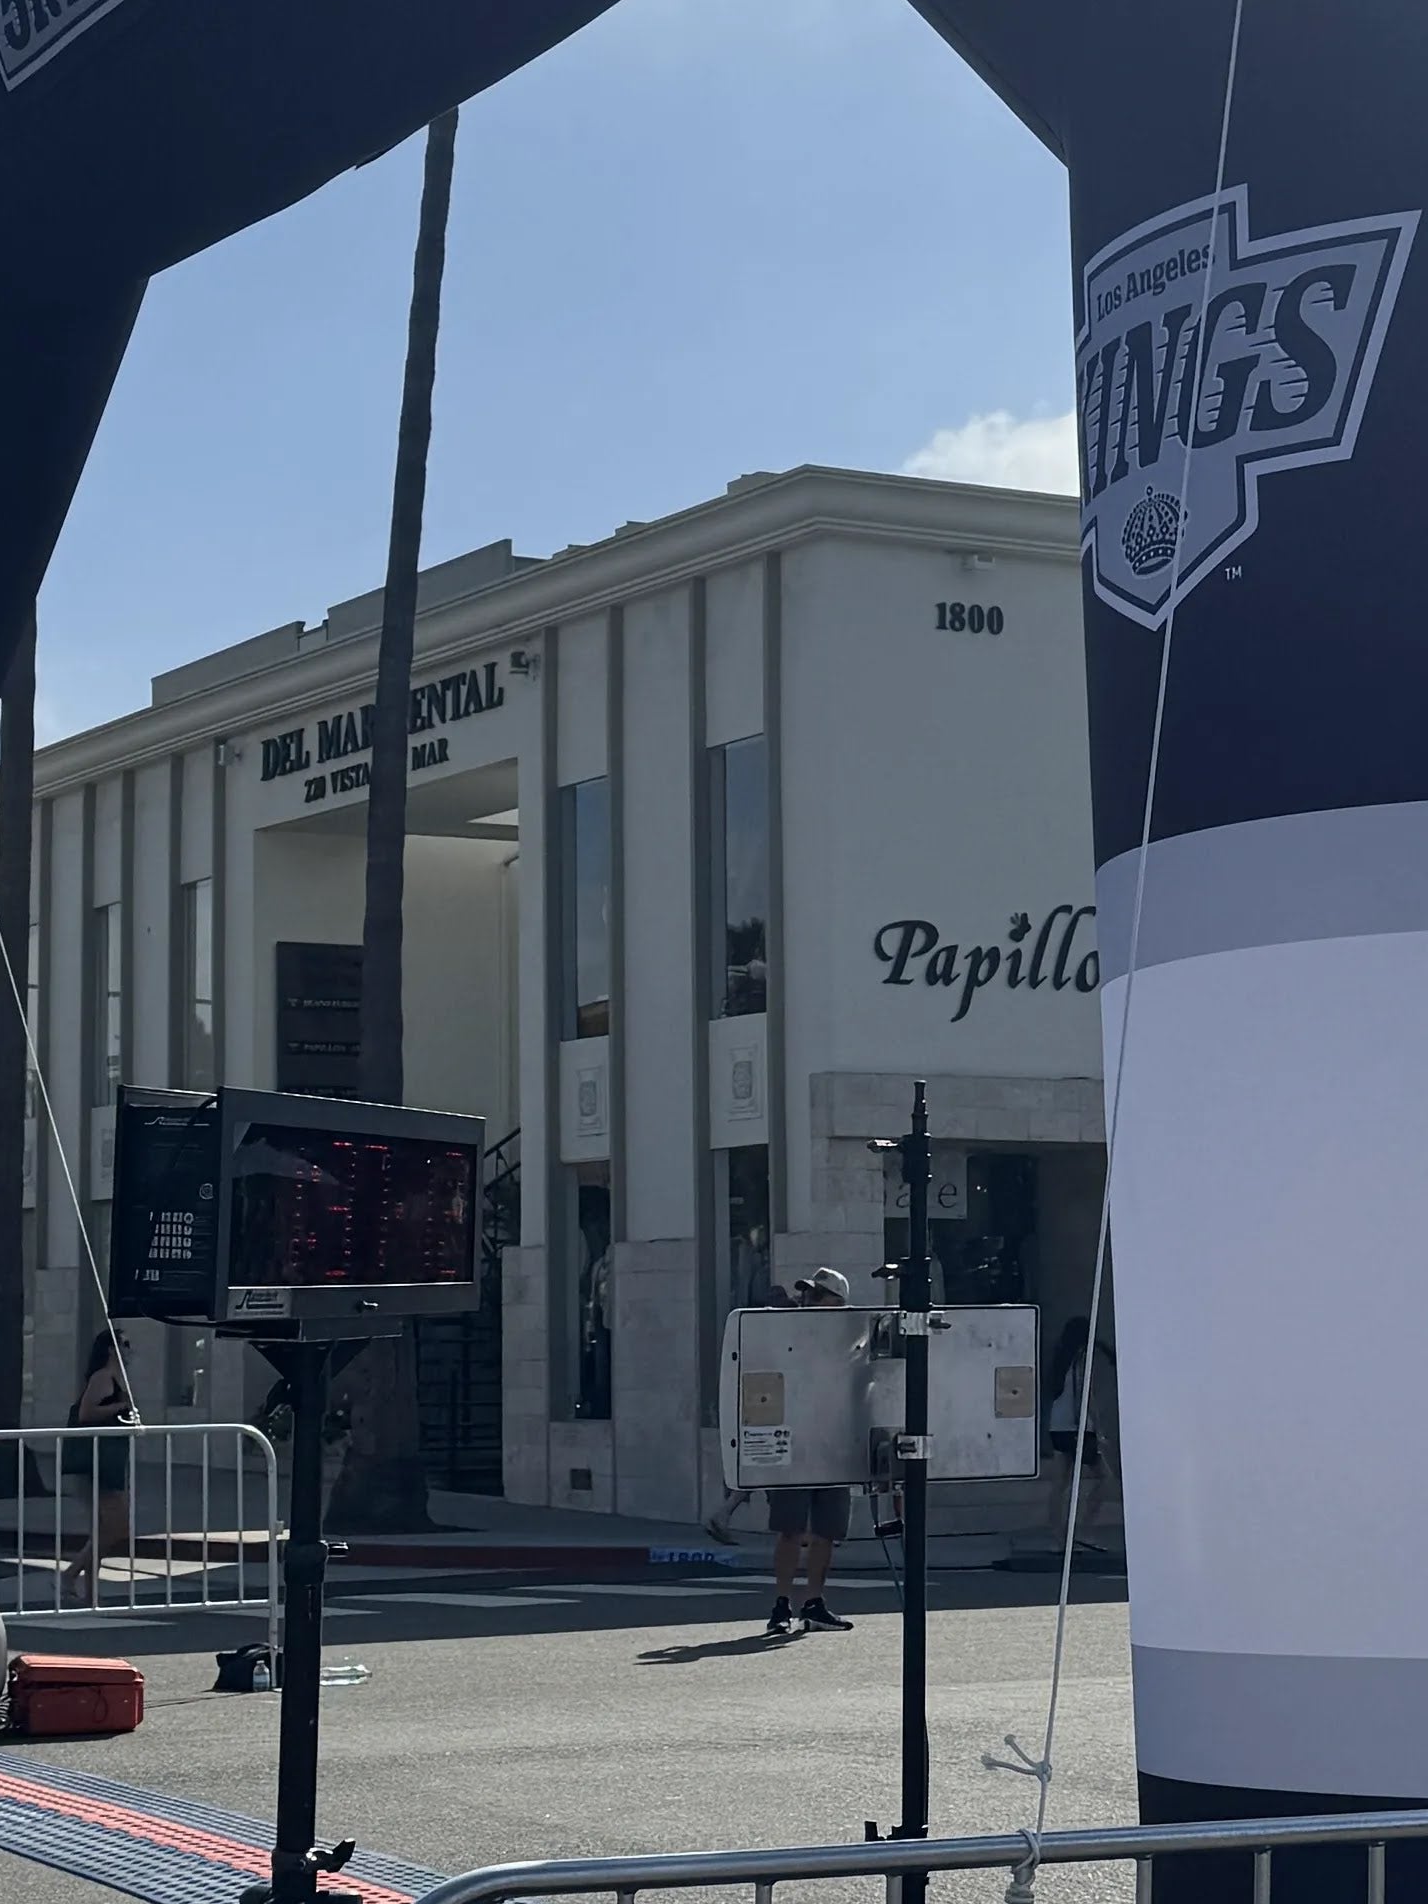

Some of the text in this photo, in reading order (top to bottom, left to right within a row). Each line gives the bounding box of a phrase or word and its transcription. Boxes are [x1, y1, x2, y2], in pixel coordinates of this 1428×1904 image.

[1097, 244, 1216, 322] Los Angeles
[1079, 263, 1358, 508] INGS
[935, 602, 1004, 635] 1800
[260, 728, 311, 782] DEL
[408, 661, 504, 735] ENTAL
[411, 737, 450, 772] MAR
[874, 904, 1100, 1022] Papillo
